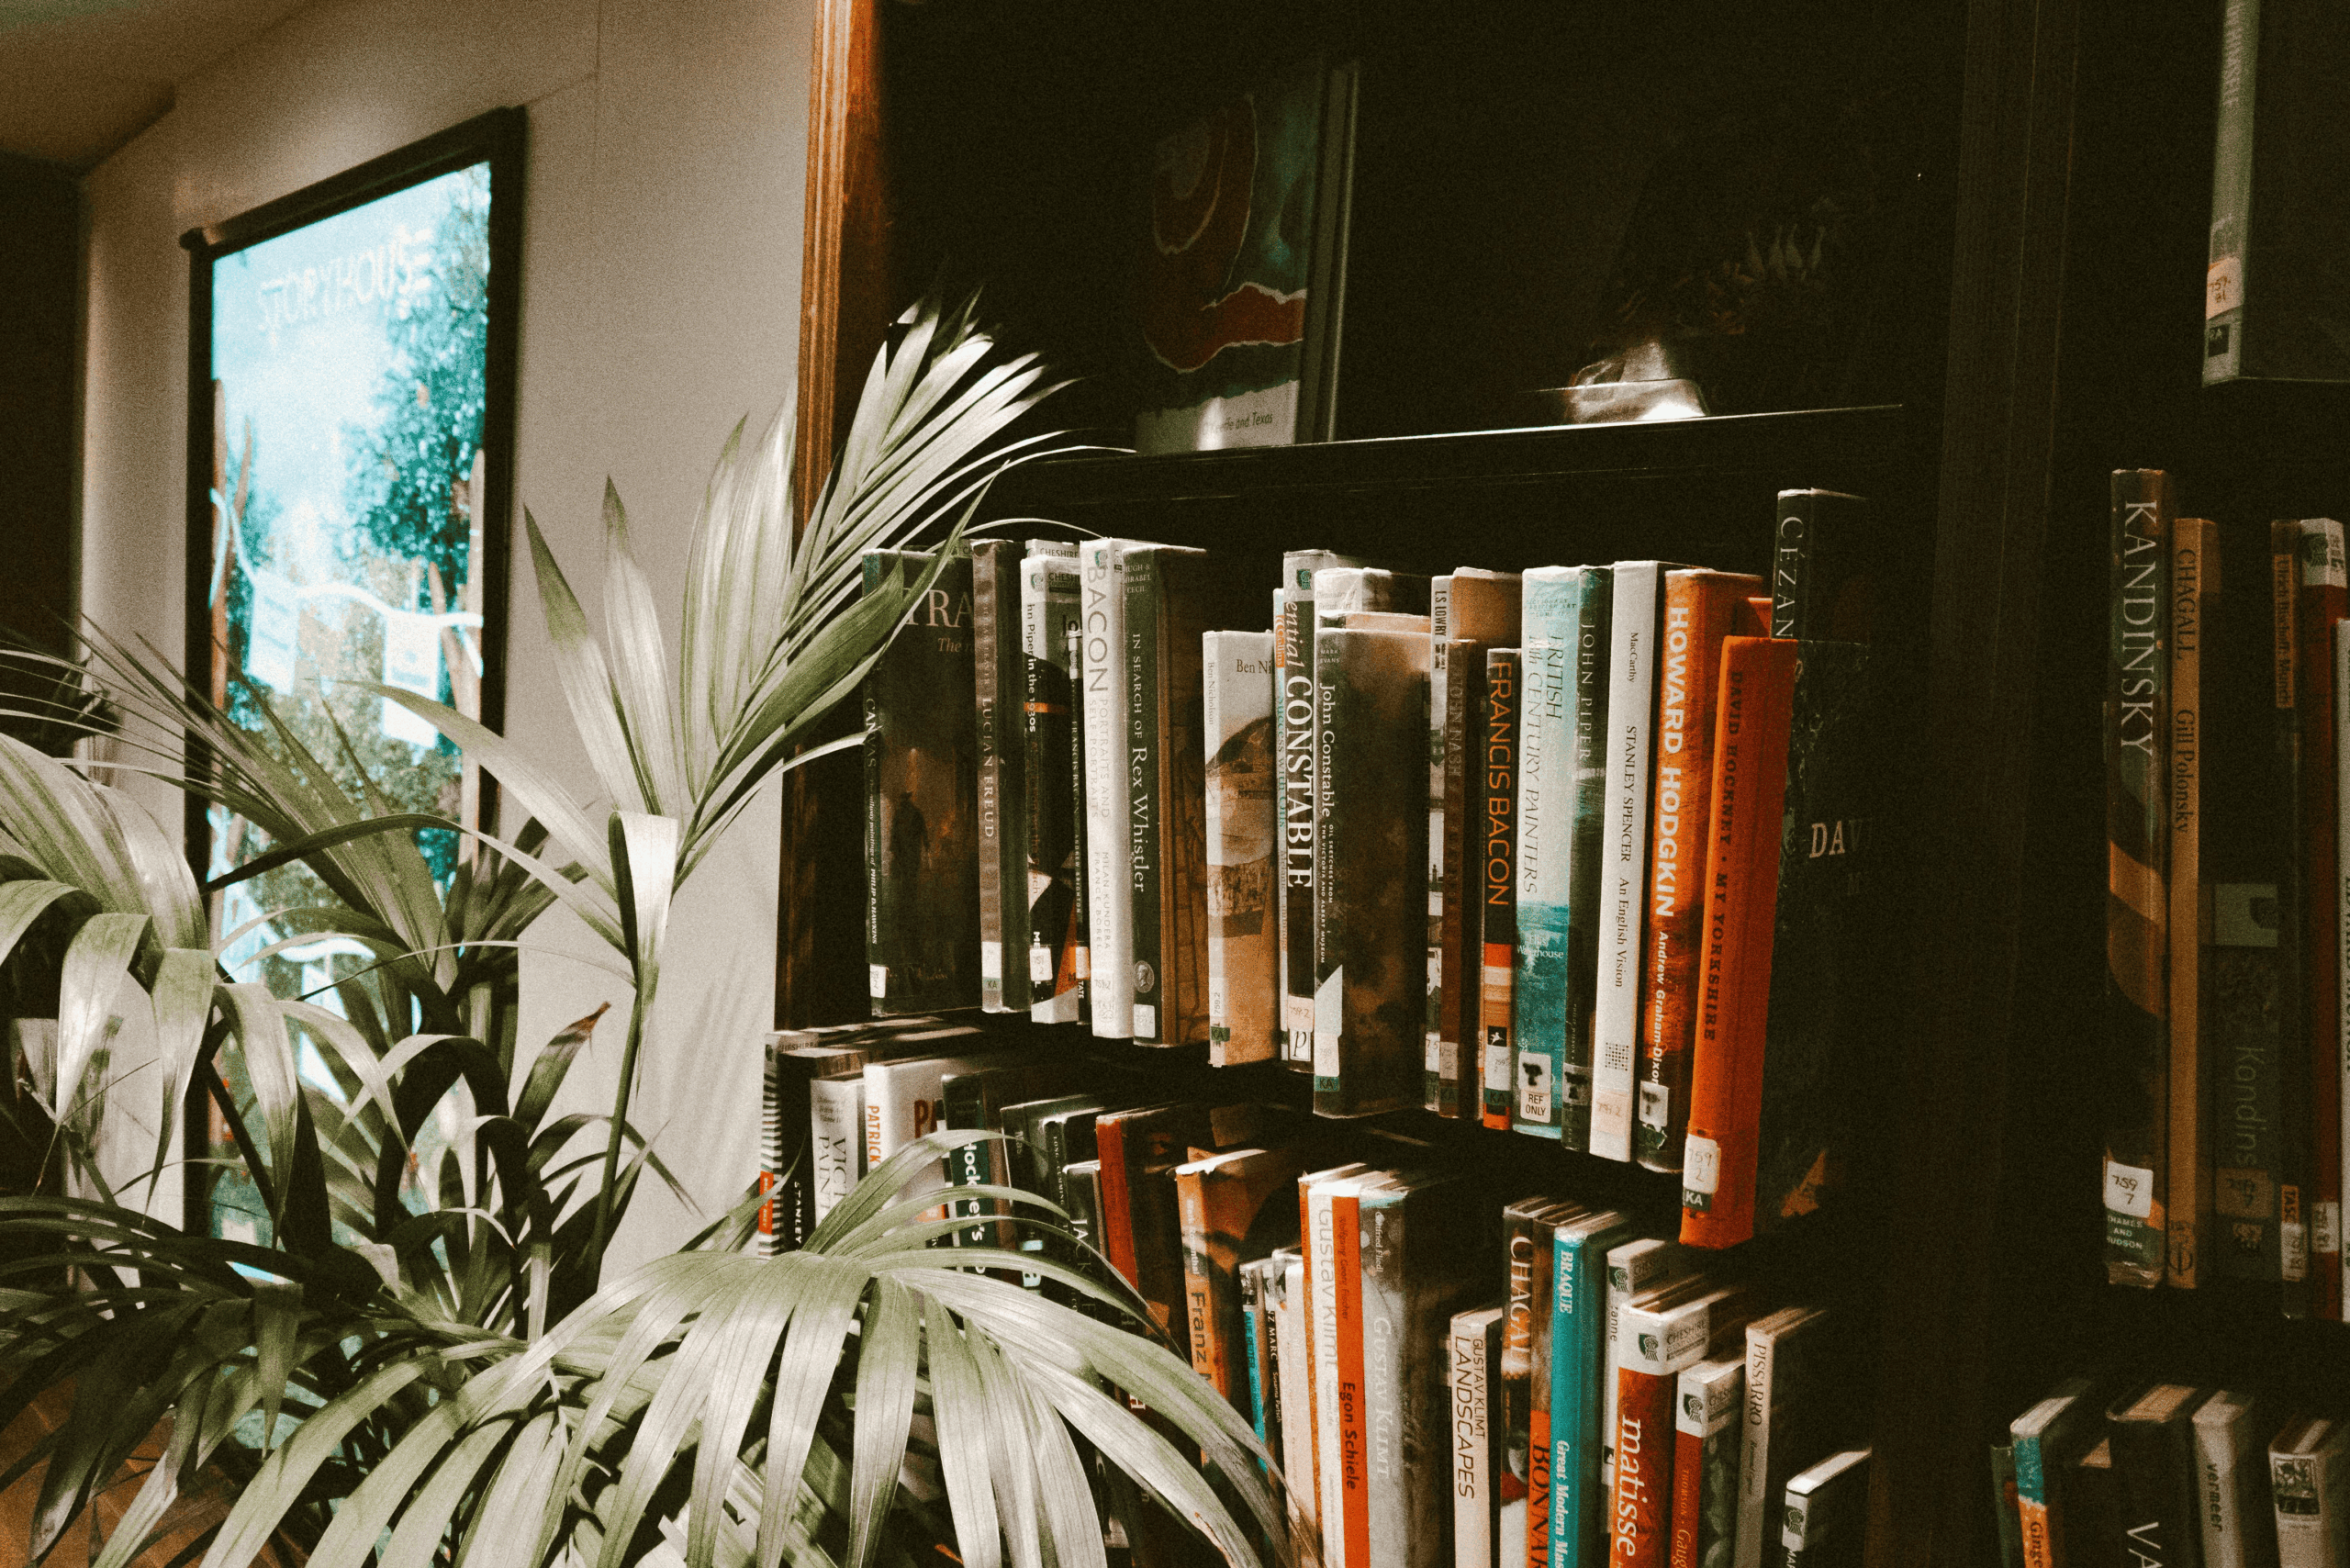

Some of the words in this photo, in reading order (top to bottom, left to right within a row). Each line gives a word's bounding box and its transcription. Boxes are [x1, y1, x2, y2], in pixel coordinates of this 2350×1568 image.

[1252, 411, 1273, 426] Texas
[1775, 516, 1806, 638] CÉZAN
[2177, 548, 2197, 661] CHAGALL
[1025, 623, 1036, 655] Piper
[1087, 566, 1109, 693] BACON
[1132, 633, 1141, 649] IN
[1284, 601, 1305, 668] ential
[1435, 606, 1448, 637] LOWRY
[2121, 499, 2157, 756] KANDINSKY
[1027, 658, 1037, 671] in
[1028, 673, 1038, 694] the
[1207, 662, 1215, 678] Ben
[1237, 659, 1256, 673] Ben
[1581, 624, 1595, 685] JOHN
[1627, 632, 1639, 683] MacCarthy
[1663, 606, 1690, 754] HOWARD
[1133, 655, 1142, 713] SEARCH
[1208, 680, 1216, 725] Nicholson
[1319, 682, 1336, 724] John
[1729, 670, 1744, 736] DAVID
[982, 698, 994, 767] LUCIAN
[1027, 698, 1037, 733] 1930s
[1100, 699, 1110, 779] PORTRAITS
[1134, 720, 1143, 739] OF
[1488, 662, 1512, 790] FRANCIS
[1526, 671, 1543, 782] CENTURY
[1579, 697, 1594, 760] PIPER
[2176, 709, 2196, 744] Gill
[1132, 746, 1147, 789] Rex
[1285, 675, 1314, 888] CONSTABLE
[1322, 730, 1336, 817] Constable
[1449, 730, 1462, 777] NASH
[1624, 725, 1638, 793] STANLEY
[983, 776, 995, 838] FREUD
[1101, 786, 1110, 818] AND
[1721, 745, 1738, 846] HOCKNEY
[2175, 749, 2196, 833] Polonsky
[1133, 793, 1150, 892] Whistler
[1488, 797, 1511, 905] BACON
[1523, 789, 1540, 894] PAINTERS
[1620, 796, 1634, 862] SPENCER
[1655, 767, 1682, 917] HODGKIN
[1102, 850, 1110, 887] MILAN
[1618, 877, 1630, 895] An
[1715, 872, 1729, 903] MY
[1517, 944, 1564, 958] Waterhouse
[1616, 900, 1629, 946] English
[1615, 949, 1628, 988] Vision
[1656, 931, 1670, 985] Andrew
[1704, 913, 1726, 1041] YORKSHIRE
[1525, 1103, 1546, 1116] ONLY
[1528, 1093, 1544, 1104] REF
[2235, 1047, 2267, 1167] Kandins
[867, 1104, 881, 1165] PATRICK
[1685, 1190, 1703, 1206] KA
[1318, 1209, 1336, 1298] Gustav
[2113, 1227, 2133, 1238] AND
[1341, 1288, 1349, 1320] Fischer
[1557, 1249, 1574, 1314] BRAQUE
[1191, 1292, 1208, 1363] Franz
[1269, 1327, 1278, 1361] MARC
[1322, 1305, 1339, 1371] Klimt
[1472, 1338, 1484, 1394] GUSTAV
[1749, 1342, 1767, 1427] PISSARRO
[1339, 1382, 1356, 1423] Egon
[1455, 1336, 1475, 1499] LANDSCAPES
[1473, 1397, 1485, 1439] KLIMT
[1344, 1429, 1360, 1489] Schiele
[1555, 1439, 1571, 1481] Great
[1617, 1414, 1649, 1557] matisse
[1555, 1482, 1570, 1536] Modern
[1680, 1469, 1689, 1517] THOMSON
[2207, 1463, 2223, 1532] vermeer
